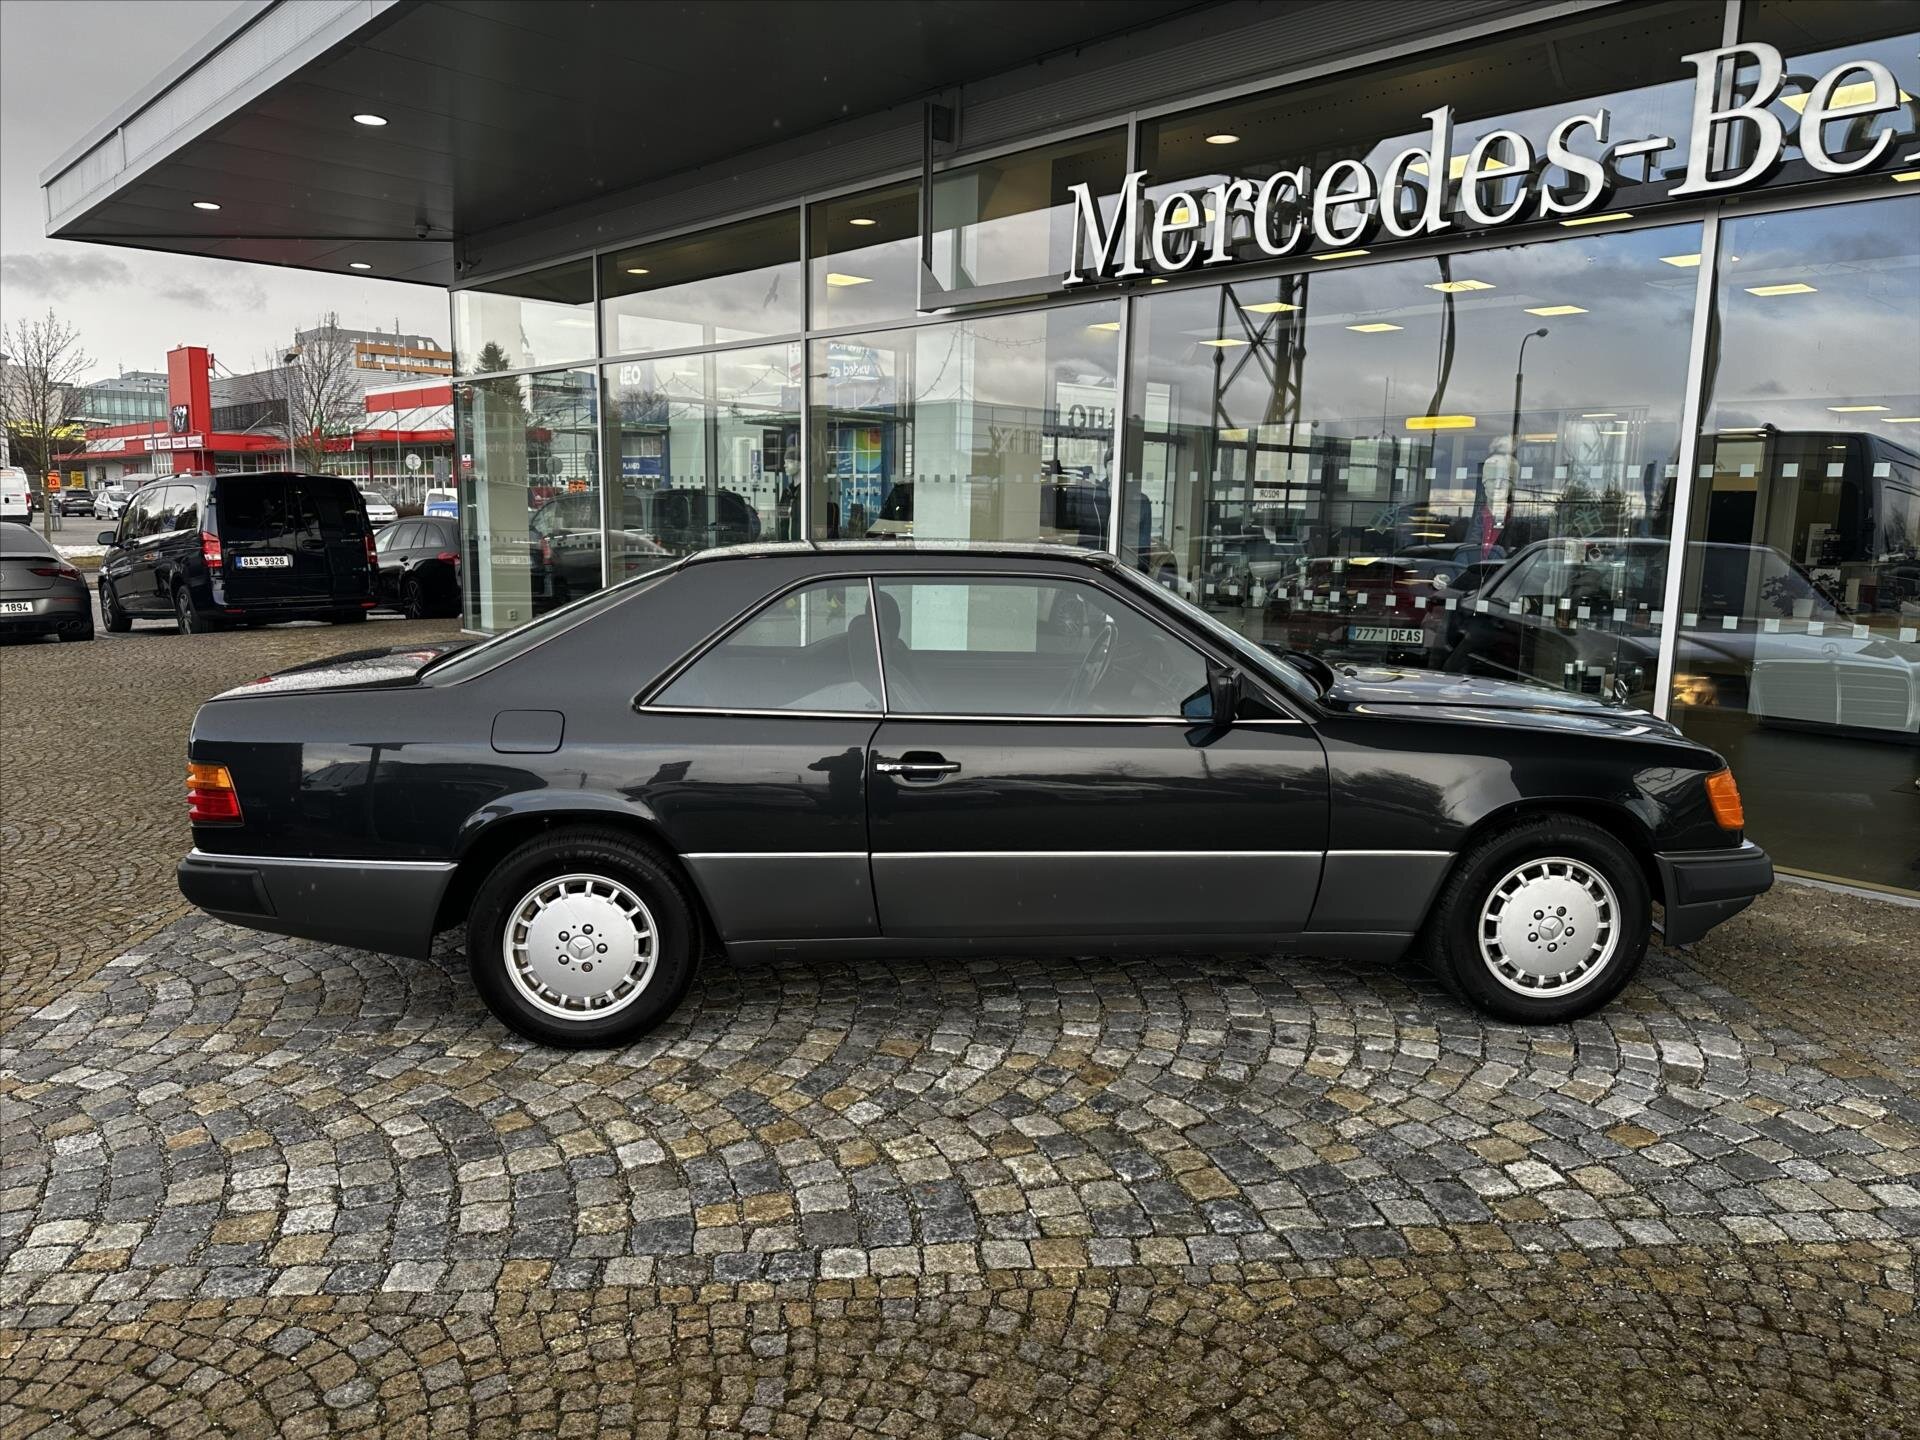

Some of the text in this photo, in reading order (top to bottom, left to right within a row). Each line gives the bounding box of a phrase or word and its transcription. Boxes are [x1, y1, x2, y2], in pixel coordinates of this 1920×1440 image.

[1063, 41, 1920, 287] Mercedes-Be
[243, 556, 285, 567] 8AS 9926
[5, 602, 28, 612] 1894
[1356, 628, 1421, 642] 777 DEAS
